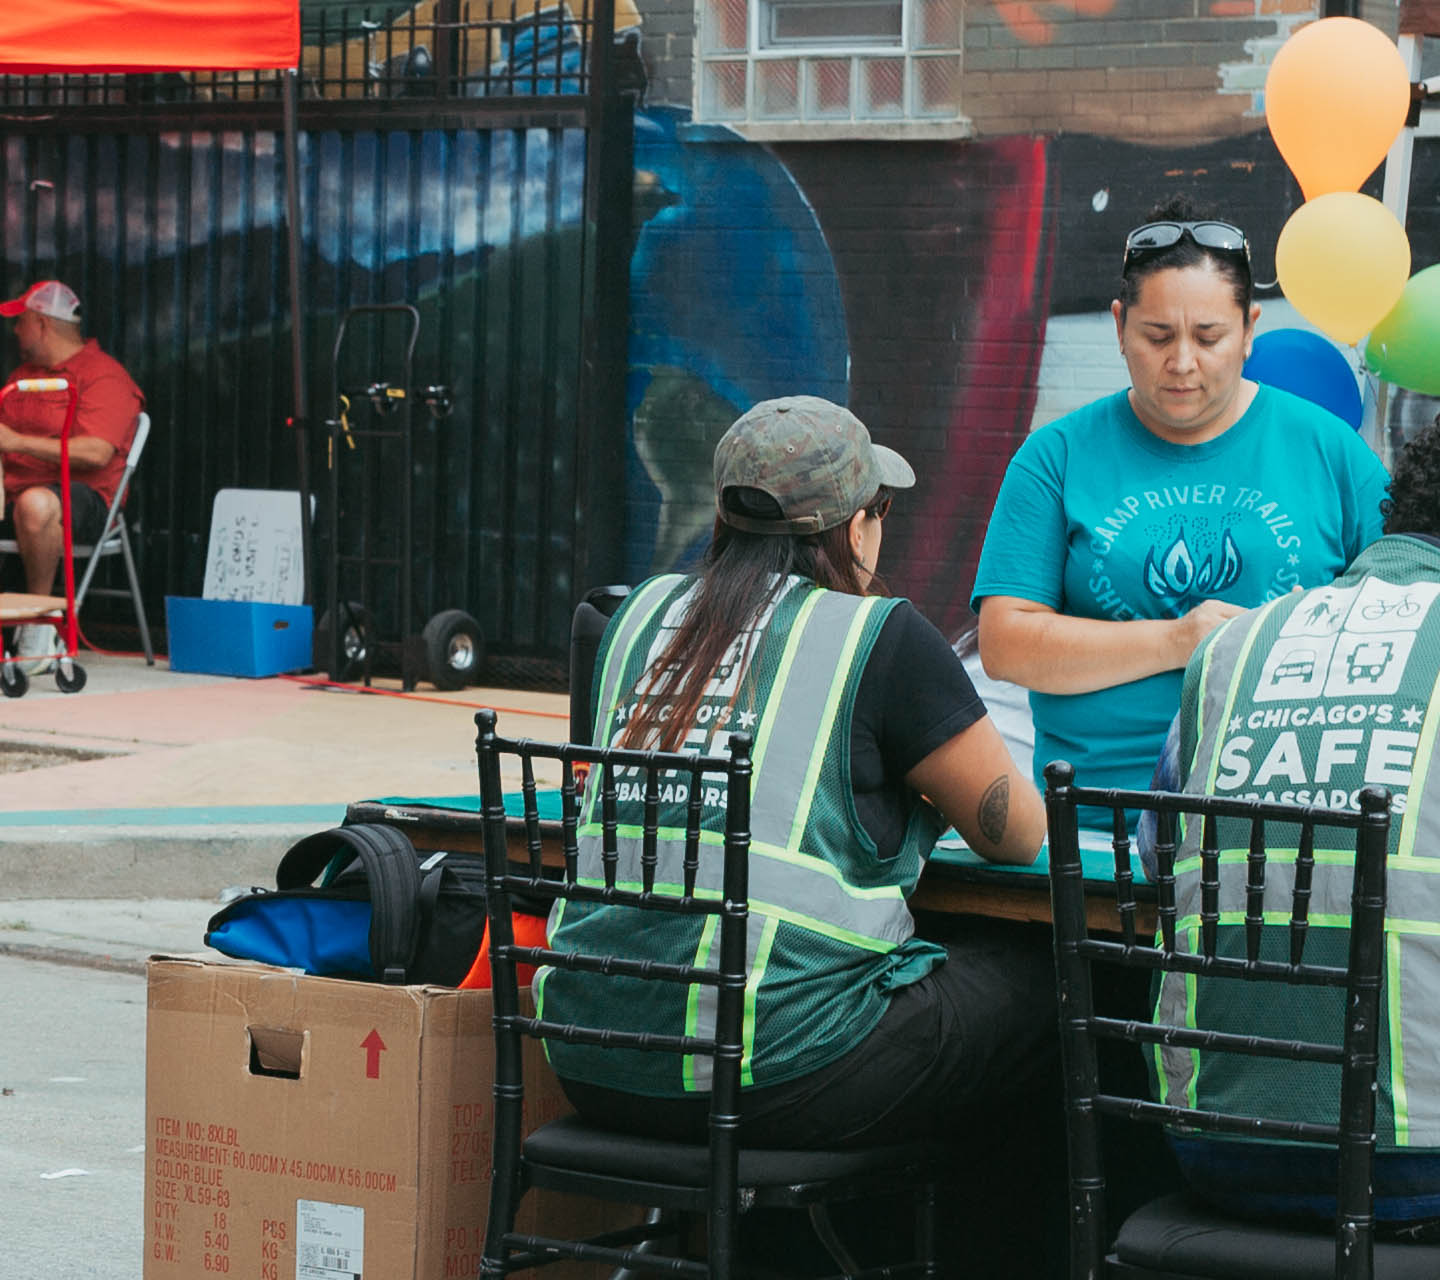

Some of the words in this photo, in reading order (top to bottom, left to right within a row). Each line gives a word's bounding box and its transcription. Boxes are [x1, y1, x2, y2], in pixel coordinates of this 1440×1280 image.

[1090, 494, 1140, 556] CAMP
[1143, 483, 1226, 510] RIVER
[1232, 486, 1301, 550] TRAILS
[1247, 704, 1394, 730] CHICAGO'S
[1215, 728, 1420, 791] SAFE
[453, 1103, 483, 1128] TOP
[156, 1117, 180, 1138] ITEM
[186, 1121, 205, 1141] NO:
[207, 1123, 241, 1148] 8XLBL
[155, 1138, 231, 1167] MEASUREMENT:
[233, 1152, 279, 1175] 60.00CM
[280, 1159, 287, 1175] X
[289, 1160, 337, 1182] 45.00CM
[338, 1167, 346, 1185] X
[347, 1169, 397, 1193] 56.00CM
[155, 1179, 180, 1200] SIZE:
[184, 1185, 197, 1204] XL
[197, 1186, 231, 1209] 59-63
[154, 1220, 181, 1242] N.W.:
[204, 1231, 230, 1252] 5.40
[261, 1240, 279, 1261] KG
[213, 1211, 227, 1230] 18
[261, 1219, 287, 1241] PCS
[446, 1227, 467, 1250] PO
[153, 1241, 181, 1263] G.W.:
[204, 1252, 230, 1273] 6.90
[261, 1261, 279, 1280] KG
